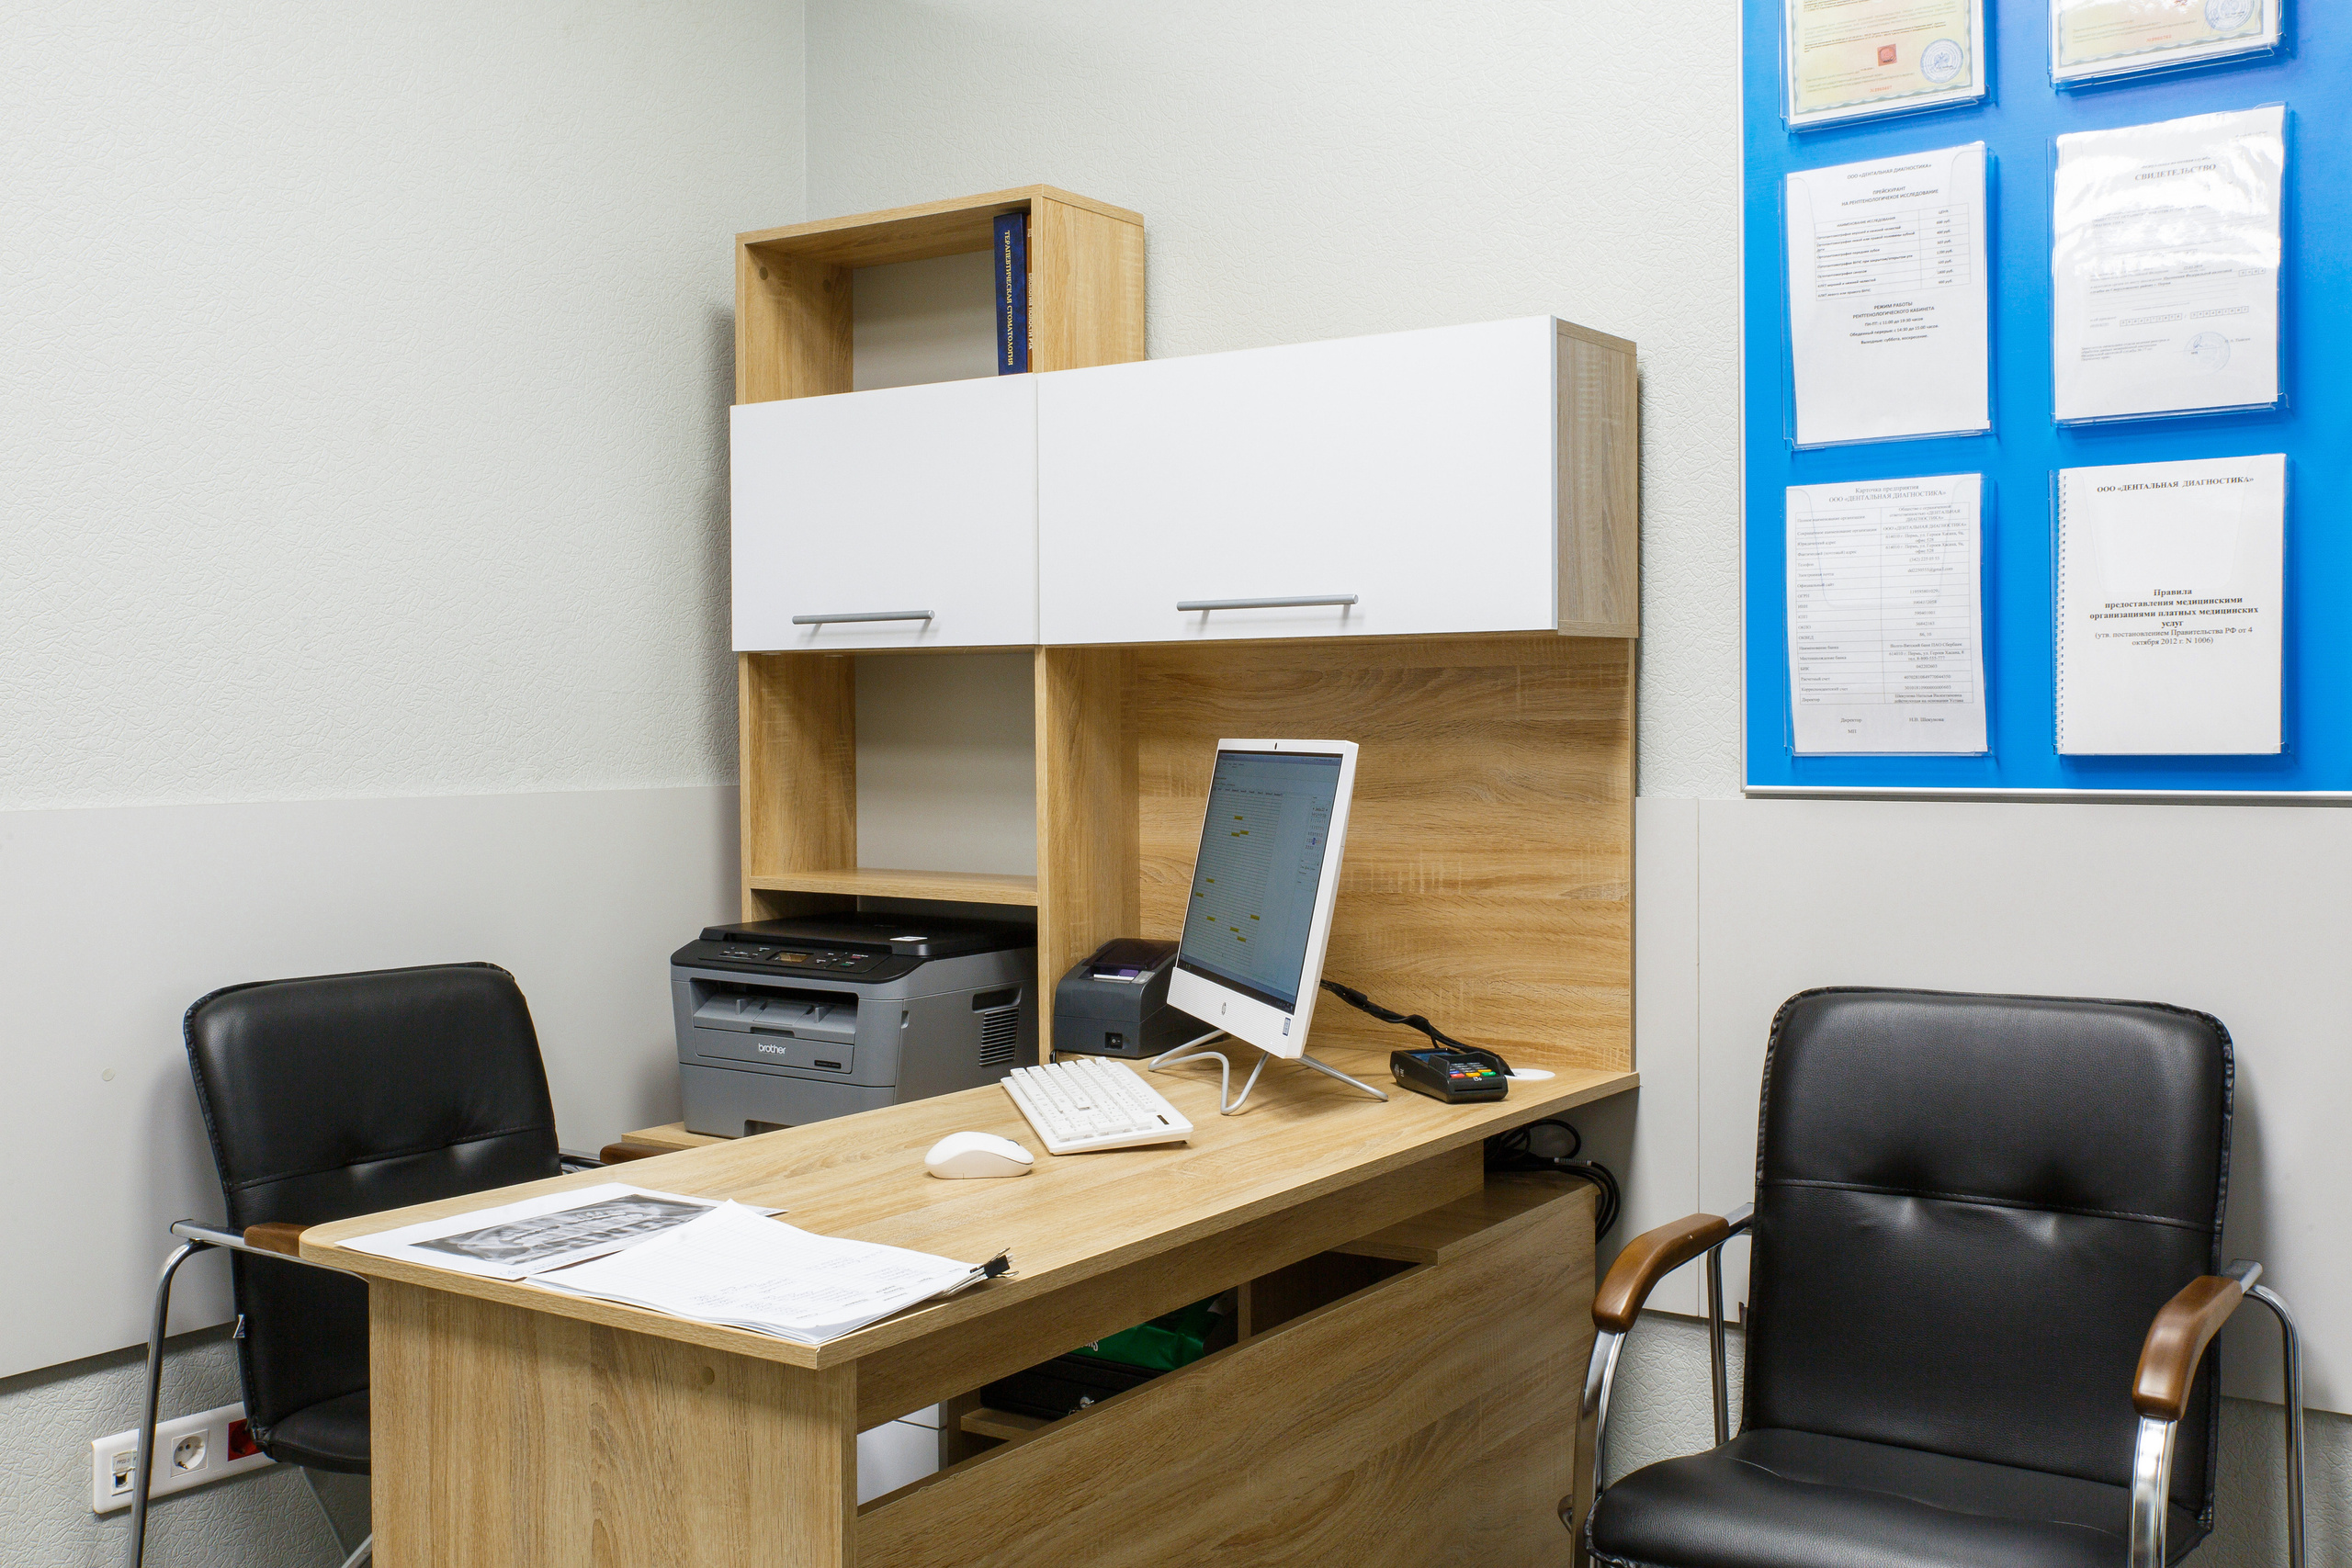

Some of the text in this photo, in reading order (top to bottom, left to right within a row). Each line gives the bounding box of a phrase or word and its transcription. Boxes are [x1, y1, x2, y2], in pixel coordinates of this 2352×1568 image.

[1859, 169, 1893, 177] «ДЕНТАЛЬНАЯ
[2135, 164, 2216, 180] СВИДЕТЕЛЬСТВО
[1900, 189, 1939, 197] ИССЛЕДОВАНИЕ
[1004, 230, 1012, 304] ТЕРАПЕВТИЧЕСКАЯ
[1853, 309, 1909, 319] РЕНТГЕНОЛОГИЧЕСКОГО
[2118, 481, 2178, 491] «ДЕНТАЛЬНАЯ
[2183, 477, 2254, 487] ДИАГНОСТИКА»
[1845, 493, 1892, 502] «ДЕНТАЛЬНАЯ
[1893, 491, 1946, 499] ДИАГНОСТИКА»
[2154, 589, 2192, 597] Правила
[2105, 601, 2174, 610] предоставления
[2089, 612, 2155, 620] организациями
[758, 1043, 786, 1055] brother
